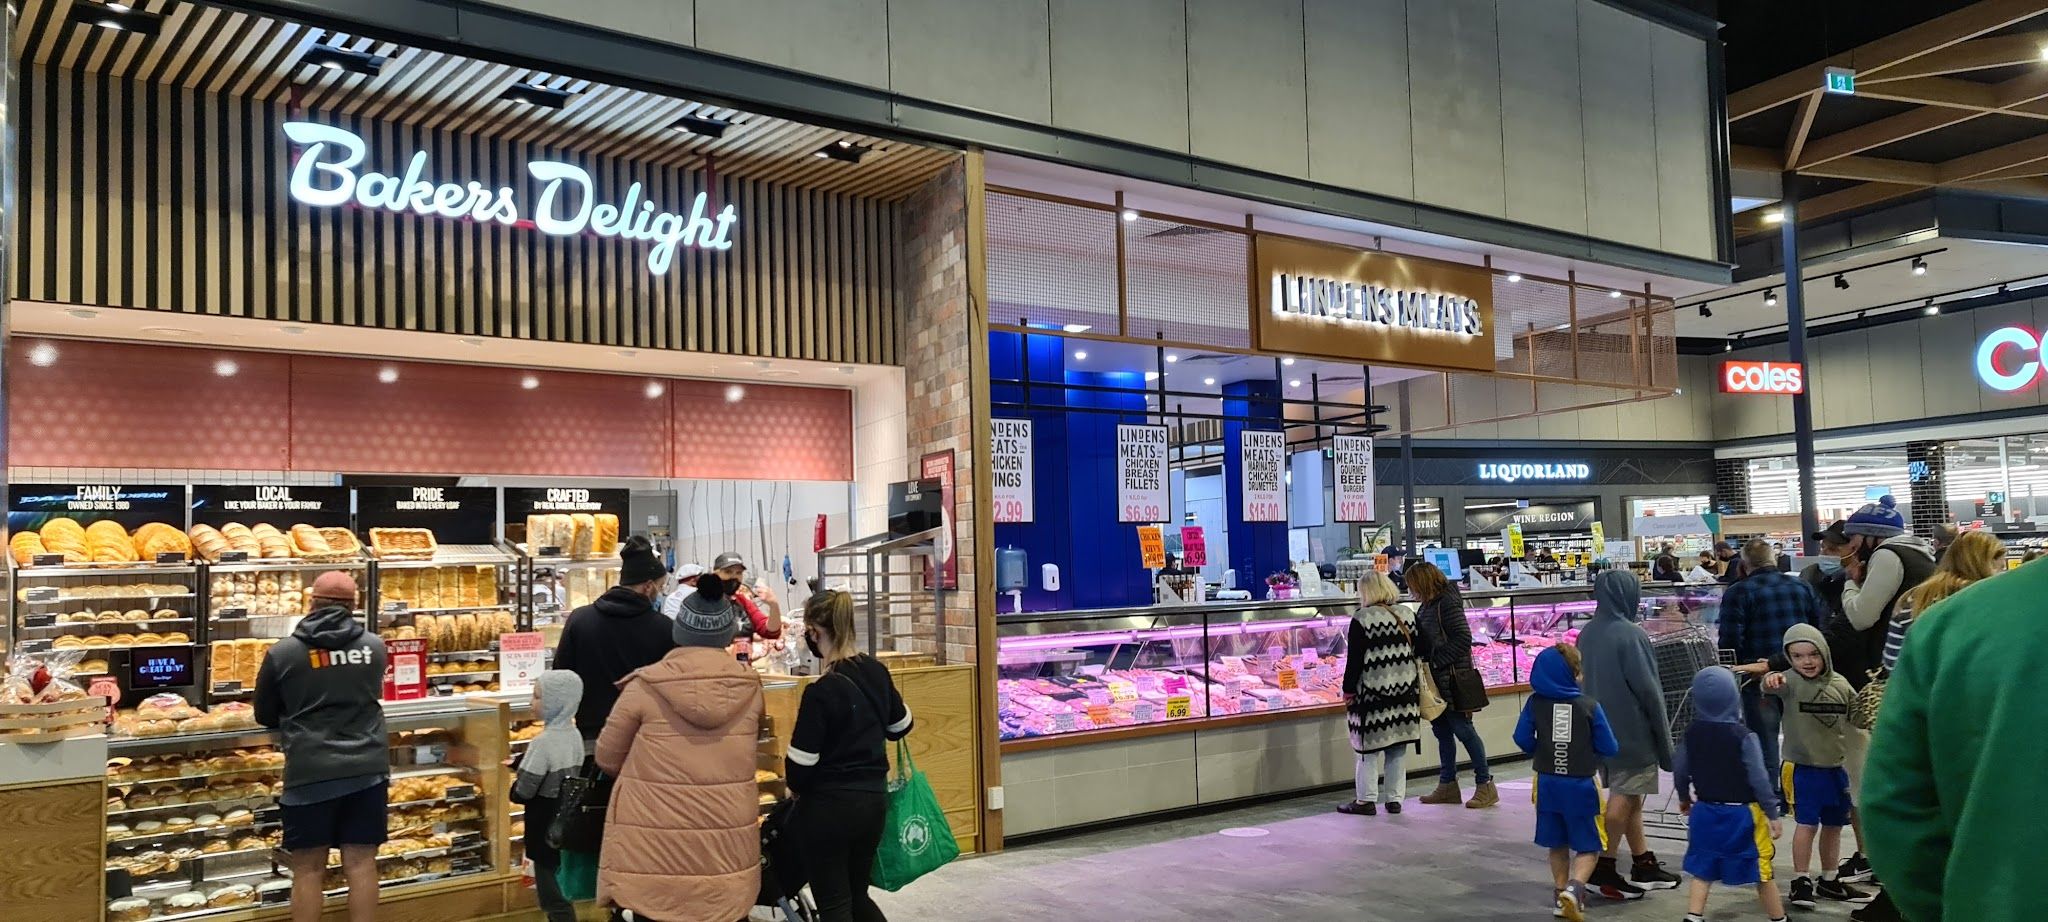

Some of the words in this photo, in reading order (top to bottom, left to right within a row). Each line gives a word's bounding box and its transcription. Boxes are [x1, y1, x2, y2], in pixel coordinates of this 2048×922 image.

[283, 122, 518, 225] Bakers
[528, 161, 736, 275] Delight
[1281, 273, 1395, 325] LINDENS
[1398, 291, 1478, 334] MEATS
[1977, 327, 2048, 391] c
[1727, 362, 1801, 392] coles
[991, 422, 1028, 438] NDENS
[1120, 428, 1165, 444] LINDENS
[992, 439, 1018, 454] EATS
[1243, 434, 1283, 448] LINDENS
[1336, 439, 1371, 452] LINDENS
[1121, 444, 1156, 458] MEATS
[1244, 448, 1274, 462] MEATS
[992, 456, 1022, 470] HICKEN
[1125, 459, 1160, 469] CHICKEN
[1336, 452, 1364, 465] MEATS
[1125, 469, 1159, 478] BREAST
[1248, 461, 1278, 472] MARINATED
[1340, 465, 1366, 475] GOURMET
[1478, 464, 1589, 482] LIQUORLAND
[993, 472, 1022, 487] INGS
[1248, 471, 1278, 481] CHICKEN
[1340, 475, 1367, 485] BEEF
[1125, 479, 1160, 490] FILLETS
[1248, 481, 1278, 492] DRUMETTES
[1343, 485, 1365, 493] BURGERS
[76, 486, 121, 500] FAMILY
[256, 486, 293, 501] LOCAL
[412, 487, 444, 501] PRIDE
[547, 488, 590, 502] CRAFTED
[67, 501, 93, 510] OWNED
[94, 501, 114, 510] SINCE
[224, 501, 240, 510] LIKE
[240, 501, 257, 510] YOUR
[1125, 503, 1160, 521] $6.99
[1249, 503, 1279, 521] $15.00
[1340, 501, 1368, 521] $17.00
[1513, 515, 1537, 523] WINE
[1540, 512, 1574, 523] REGION
[309, 645, 373, 669] iinet
[1554, 705, 1570, 775] BROOKLYN
